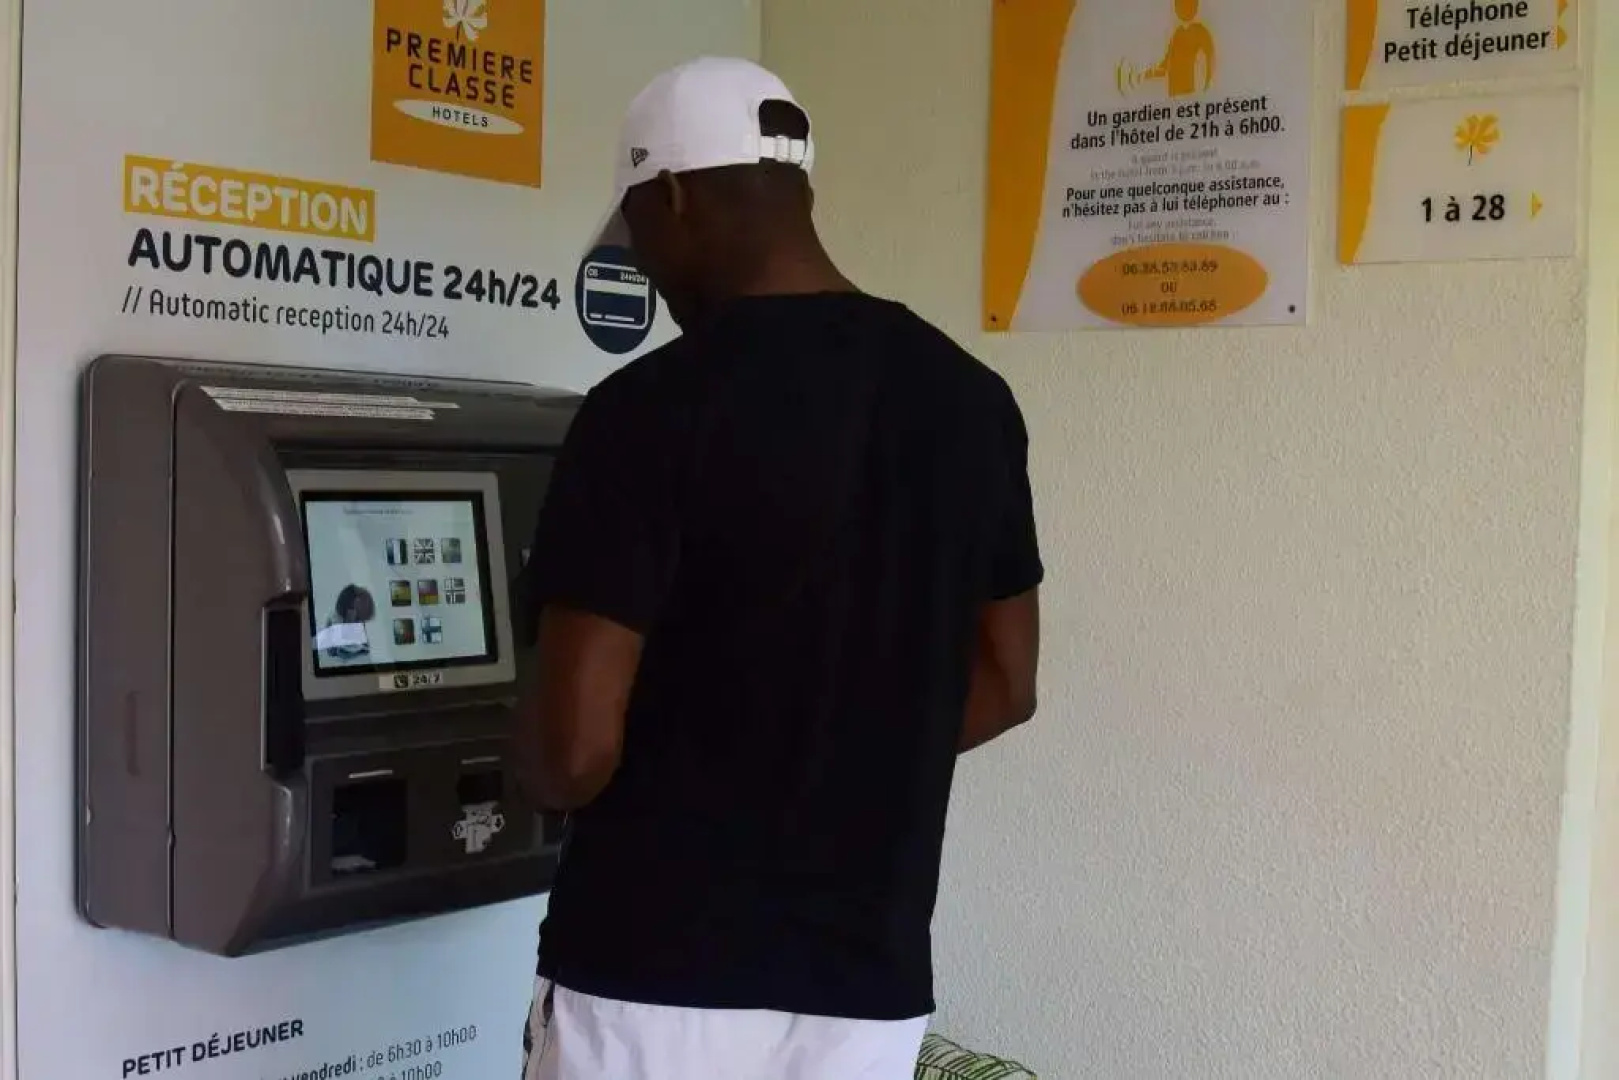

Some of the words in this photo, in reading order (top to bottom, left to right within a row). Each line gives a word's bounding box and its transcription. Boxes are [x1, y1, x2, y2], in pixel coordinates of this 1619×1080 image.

[1407, 0, 1528, 30] Téléphone
[386, 27, 532, 84] PREMIERE
[1384, 38, 1437, 63] Petit
[1445, 30, 1550, 60] déjeuner
[408, 63, 515, 109] CLASSE
[432, 106, 489, 127] HOTELS
[1087, 110, 1107, 127] Un
[1112, 104, 1171, 128] gardien
[1177, 102, 1201, 118] est
[1205, 95, 1267, 122] présent
[1071, 134, 1105, 150] dans
[1111, 128, 1160, 147] l'hôtel
[1165, 126, 1184, 141] de
[1190, 122, 1219, 139] 21h
[1224, 121, 1234, 137] à
[1239, 116, 1285, 135] 6h00.
[130, 161, 368, 235] RÉCEPTION
[1066, 186, 1096, 202] Pour
[1099, 186, 1123, 200] une
[1127, 179, 1205, 201] quelconque
[1209, 174, 1285, 193] assistance,
[1062, 200, 1119, 219] n'hésitez
[1123, 201, 1146, 218] pas
[1150, 199, 1158, 213] à
[1162, 196, 1179, 212] lui
[1183, 193, 1259, 213] téléphoner
[1263, 194, 1280, 205] au
[1421, 198, 1433, 222] 1
[1444, 196, 1461, 222] à
[1471, 194, 1506, 221] 28
[127, 228, 433, 297] AUTOMATIQUE
[443, 265, 560, 310] 24h/24
[150, 289, 269, 324] Automatic
[276, 301, 375, 335] reception
[382, 311, 450, 338] 24h/24
[122, 1045, 187, 1079] PETIT
[192, 1019, 304, 1063] DÉJEUNER
[367, 1049, 383, 1068] de
[388, 1038, 421, 1063] 6h30
[425, 1036, 433, 1053] à
[437, 1025, 477, 1048] 10h00
